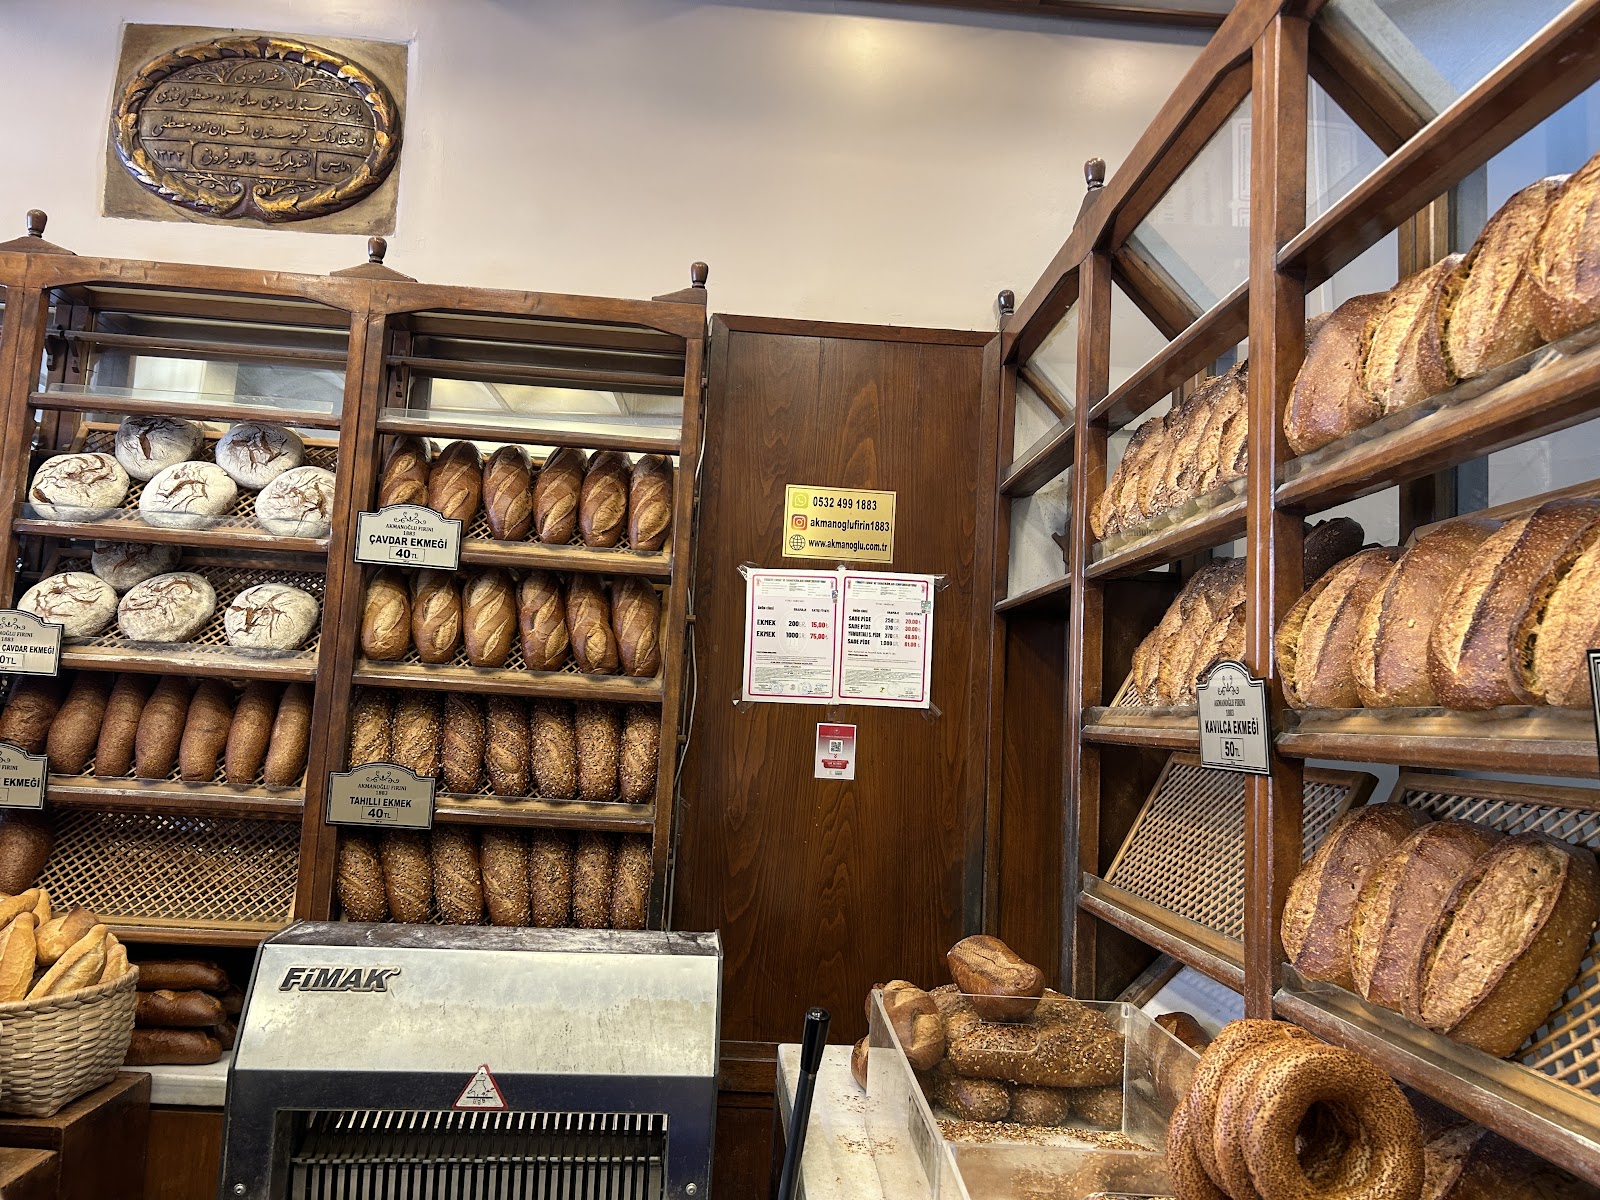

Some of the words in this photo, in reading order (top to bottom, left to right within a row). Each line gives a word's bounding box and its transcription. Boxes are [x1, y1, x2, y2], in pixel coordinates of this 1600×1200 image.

[812, 496, 836, 508] 0532
[836, 498, 854, 509] 499
[856, 500, 878, 511] 1883
[810, 517, 890, 532] akmanoglufirin1883
[369, 534, 408, 546] ÇAVDAR
[410, 539, 448, 549] EKMEĞİ
[808, 539, 888, 552] www.akmanoglu.com.tr
[756, 630, 776, 638] EKMEK
[29, 646, 55, 655] EKMEĞİ
[1205, 720, 1232, 734] KAVILCA
[1233, 717, 1259, 736] EKMEĞİ
[3, 777, 40, 788] EKMEĞİ
[350, 796, 380, 806] TAHILLI
[383, 798, 412, 808] EKMEK
